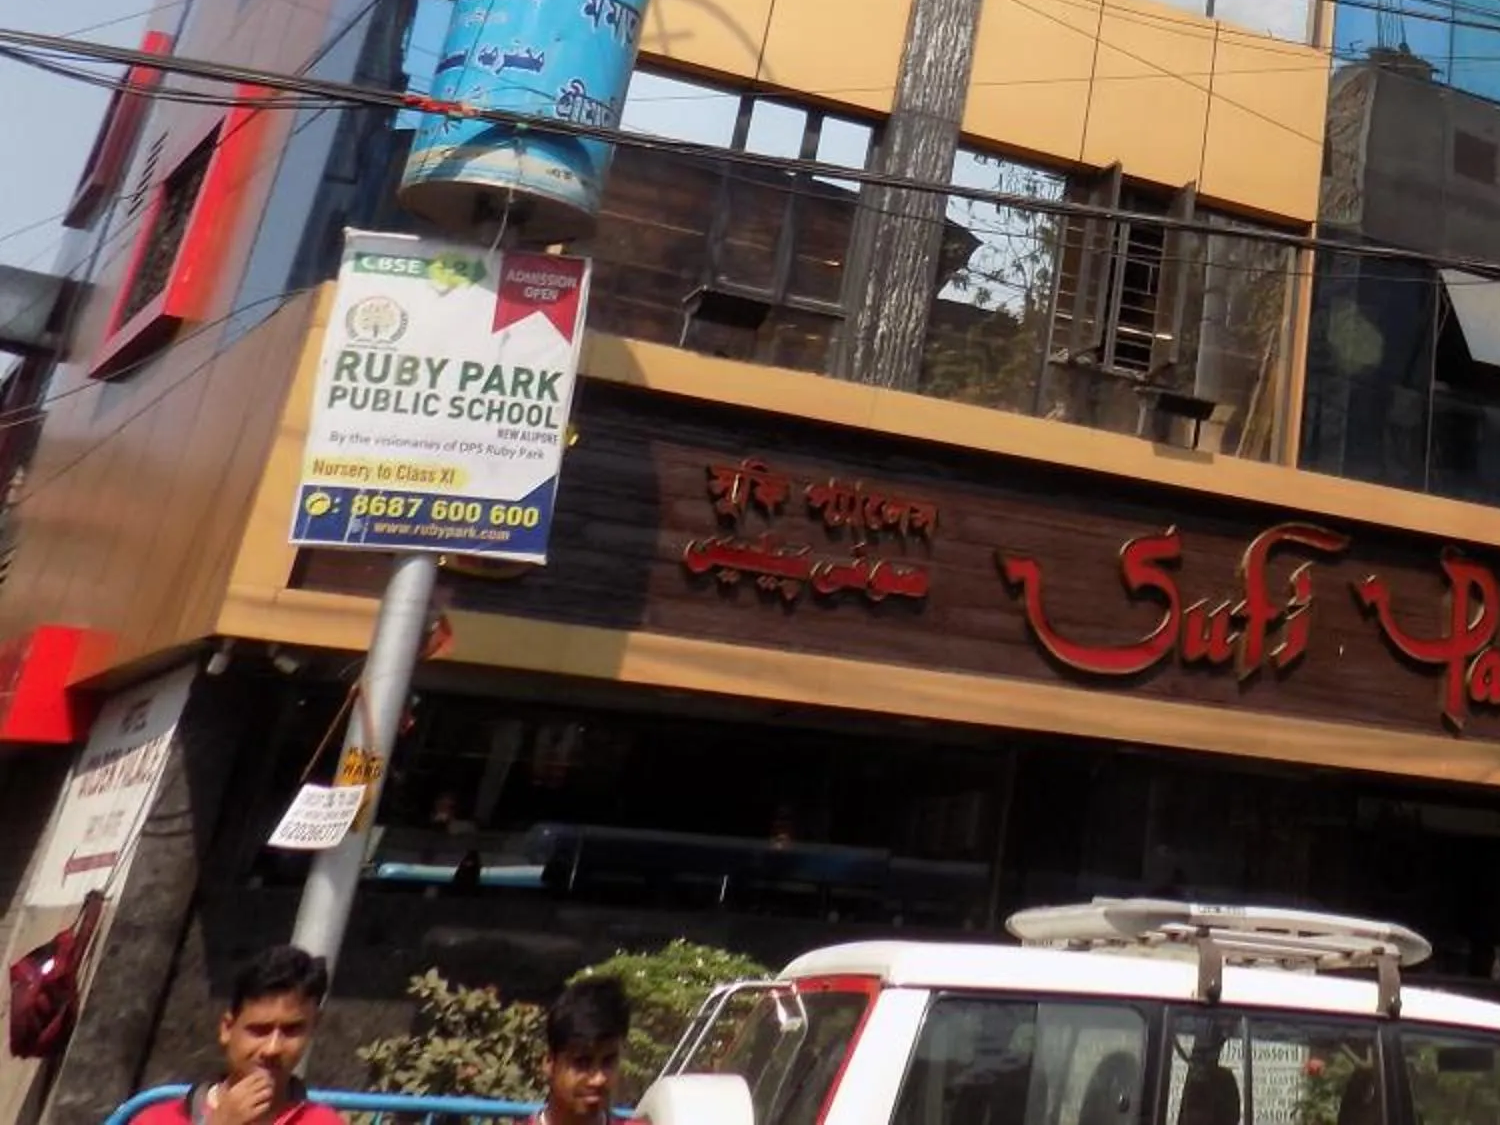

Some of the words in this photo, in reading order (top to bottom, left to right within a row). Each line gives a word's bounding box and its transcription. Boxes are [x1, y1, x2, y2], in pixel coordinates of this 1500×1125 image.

[360, 254, 422, 275] CBSE
[506, 268, 577, 288] ADMISSION
[523, 286, 560, 301] OPEN
[333, 350, 450, 390] RUBY
[458, 361, 563, 403] PARK
[327, 385, 441, 418] PUBLIC
[447, 395, 560, 430] SCHOOL
[329, 430, 346, 443] By
[350, 431, 371, 444] the
[443, 438, 458, 452] of
[459, 441, 485, 454] DPS
[485, 442, 517, 459] Ruby
[518, 446, 544, 460] Park
[312, 458, 371, 482] Nursery
[376, 462, 391, 479] to
[395, 463, 437, 483] Class
[351, 493, 424, 519] 8687
[431, 500, 482, 522] 600
[489, 505, 539, 528] 600
[1003, 523, 1349, 681] Sufi
